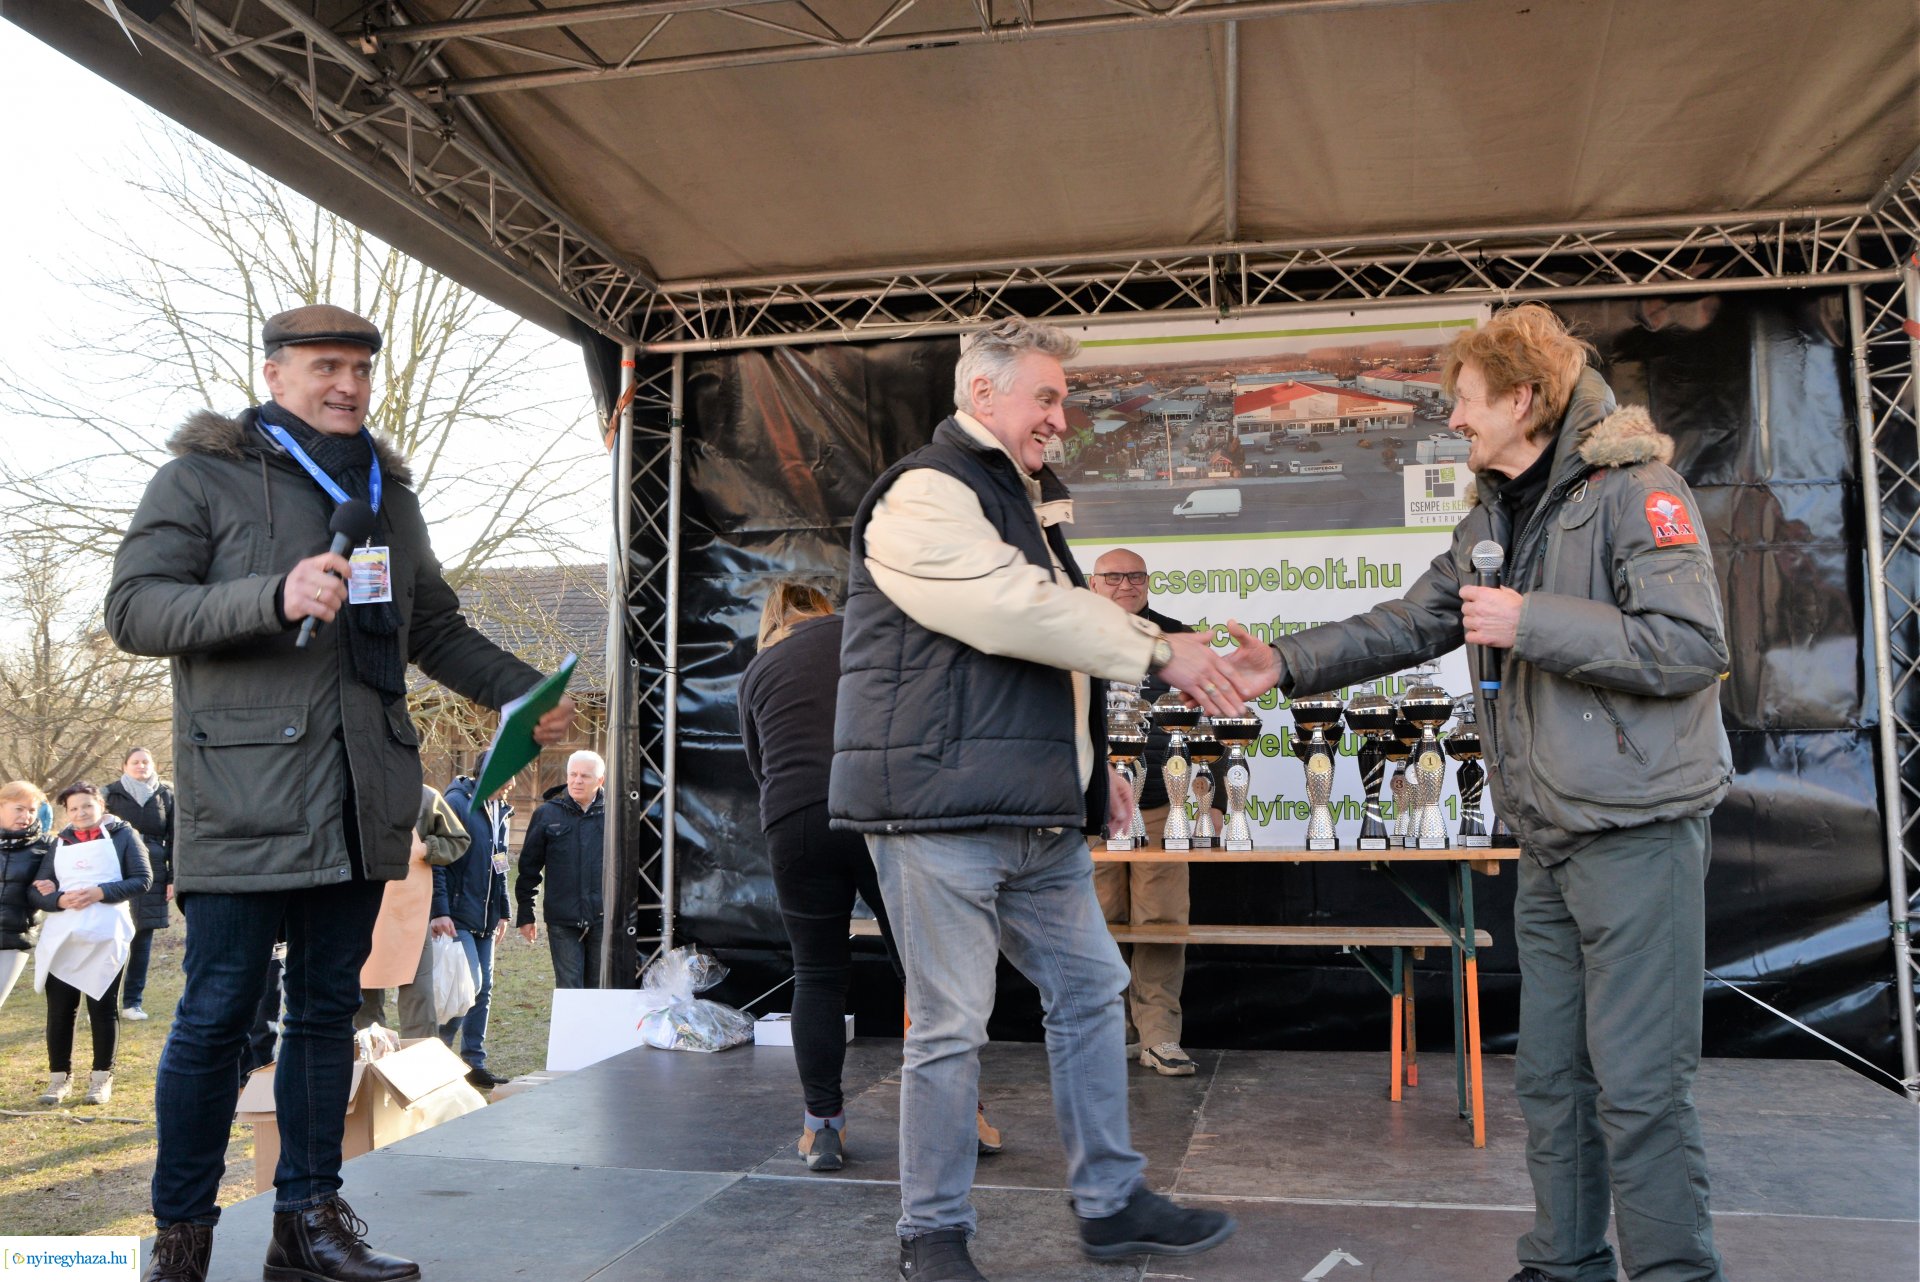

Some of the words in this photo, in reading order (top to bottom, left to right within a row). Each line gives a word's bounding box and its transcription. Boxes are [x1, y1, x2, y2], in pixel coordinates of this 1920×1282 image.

[1410, 501, 1440, 512] CSEMPE
[1452, 500, 1470, 511] KER
[1419, 515, 1462, 524] CENTRUM
[1148, 556, 1402, 600] csempebolt.hu
[1427, 757, 1433, 766] 1
[1233, 770, 1242, 780] 2
[1395, 779, 1404, 789] 3
